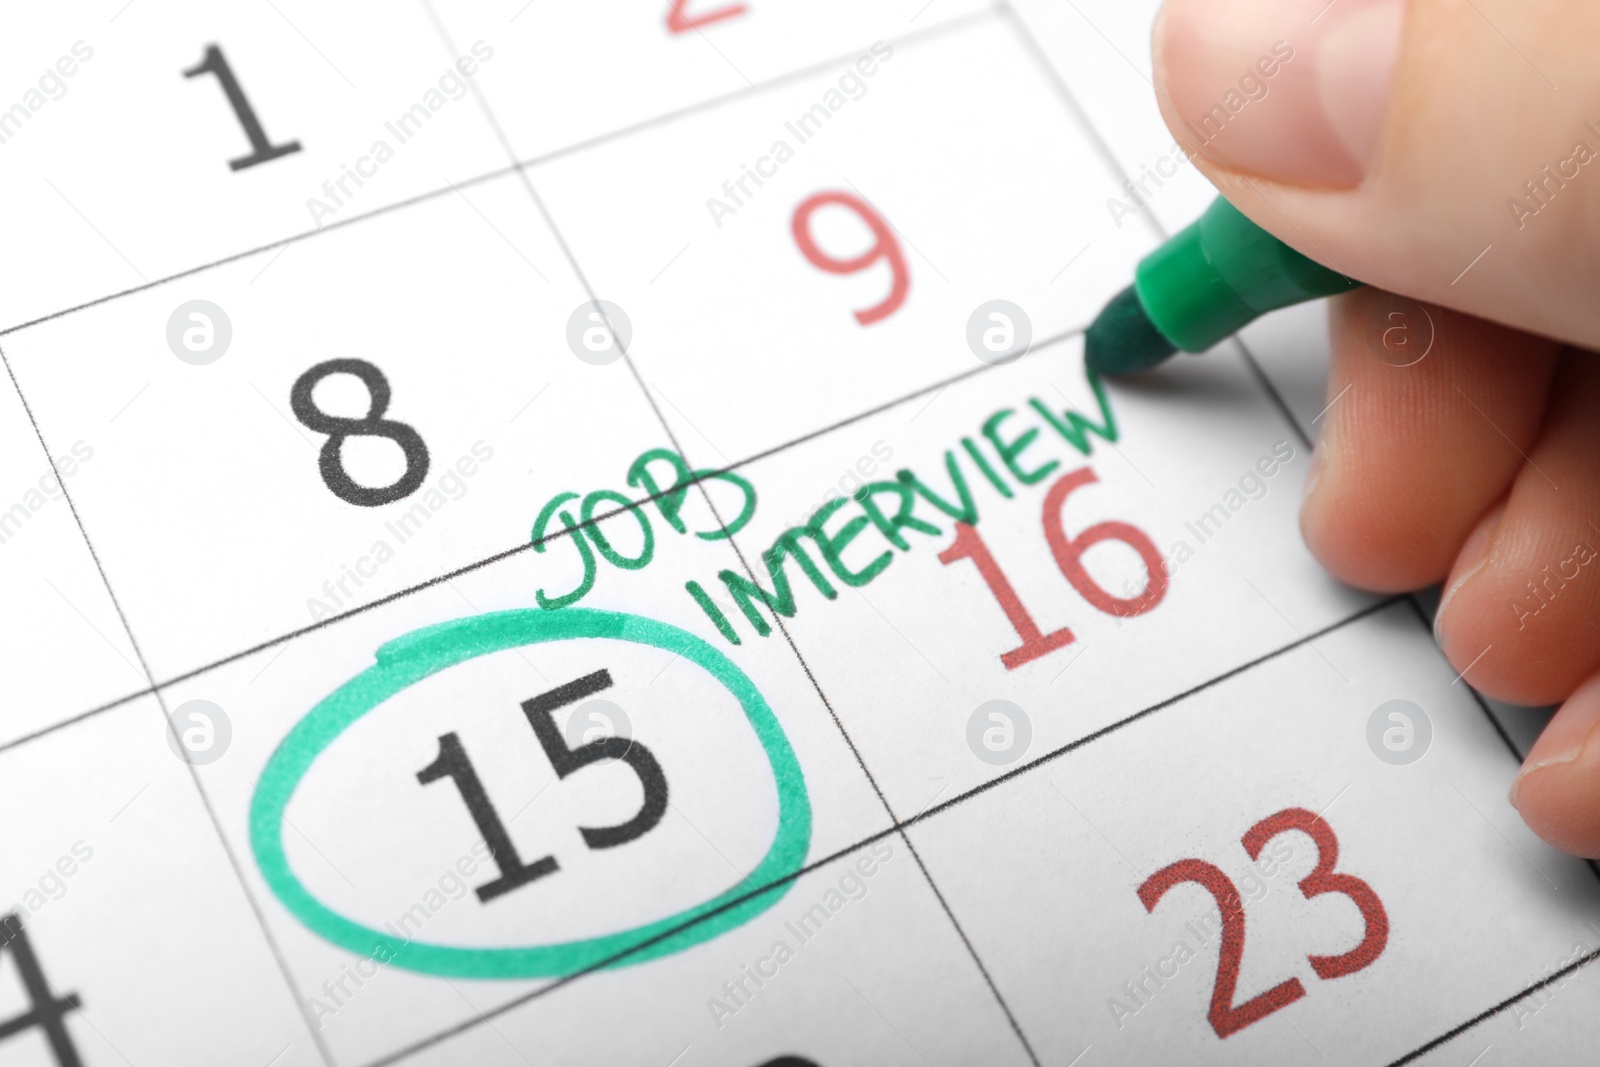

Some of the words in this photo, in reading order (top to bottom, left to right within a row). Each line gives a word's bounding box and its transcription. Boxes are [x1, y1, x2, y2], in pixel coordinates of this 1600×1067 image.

[185, 44, 302, 172] 1
[790, 189, 911, 327] 9
[289, 357, 431, 508] 8
[685, 366, 1120, 646] INTERVIEW
[530, 447, 757, 611] JOB
[938, 466, 1173, 672] 16
[416, 668, 669, 904] 15
[1136, 807, 1391, 1040] 23
